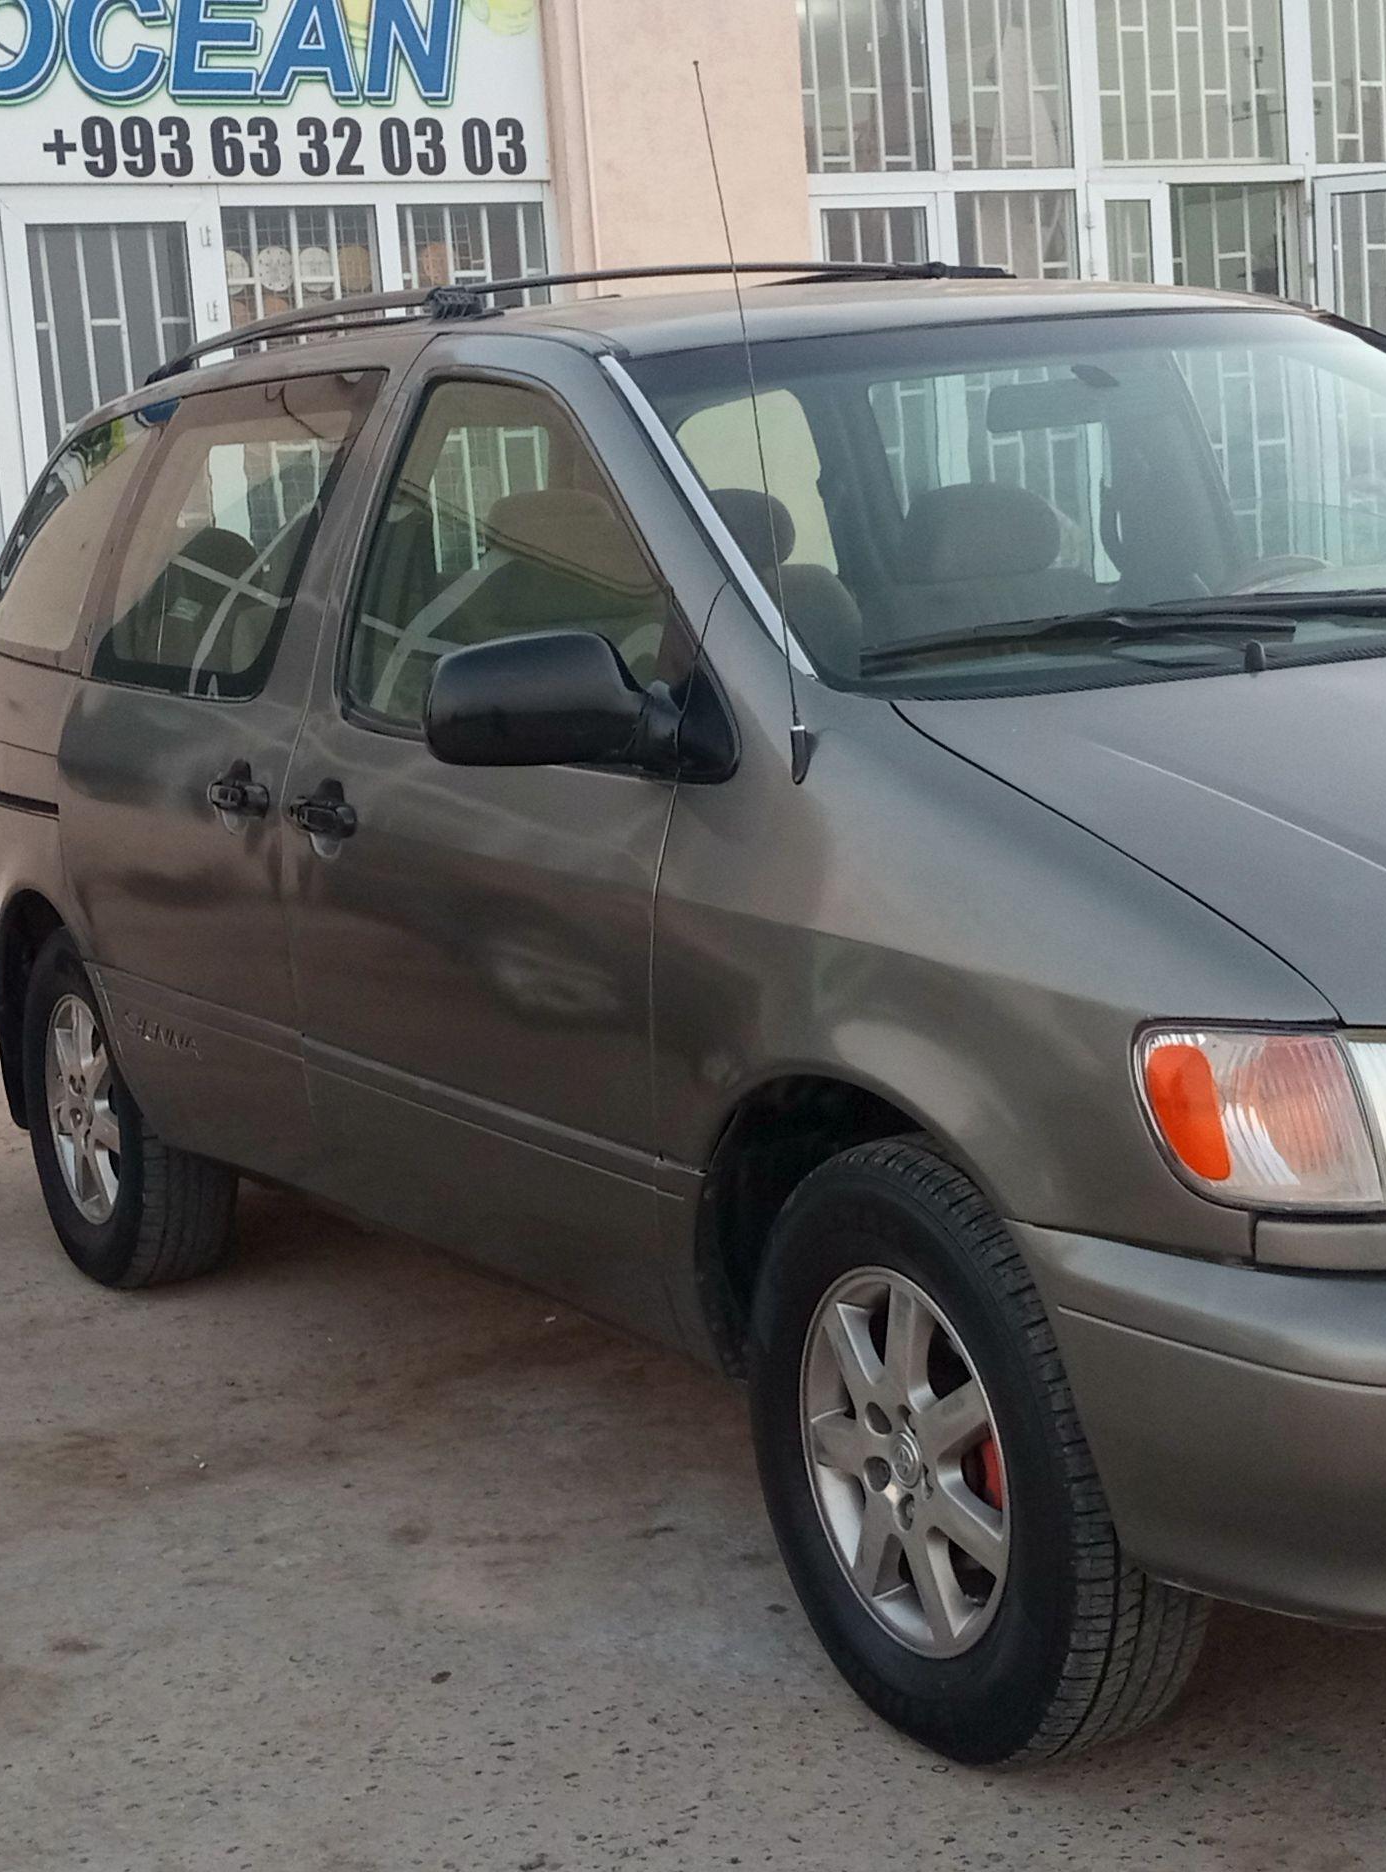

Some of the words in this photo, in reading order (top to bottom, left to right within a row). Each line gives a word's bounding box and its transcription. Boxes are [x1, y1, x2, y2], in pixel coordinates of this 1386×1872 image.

[42, 115, 194, 178] +993
[210, 116, 282, 177] 63
[296, 116, 365, 176] 32
[379, 116, 447, 177] 03
[461, 116, 528, 176] 03
